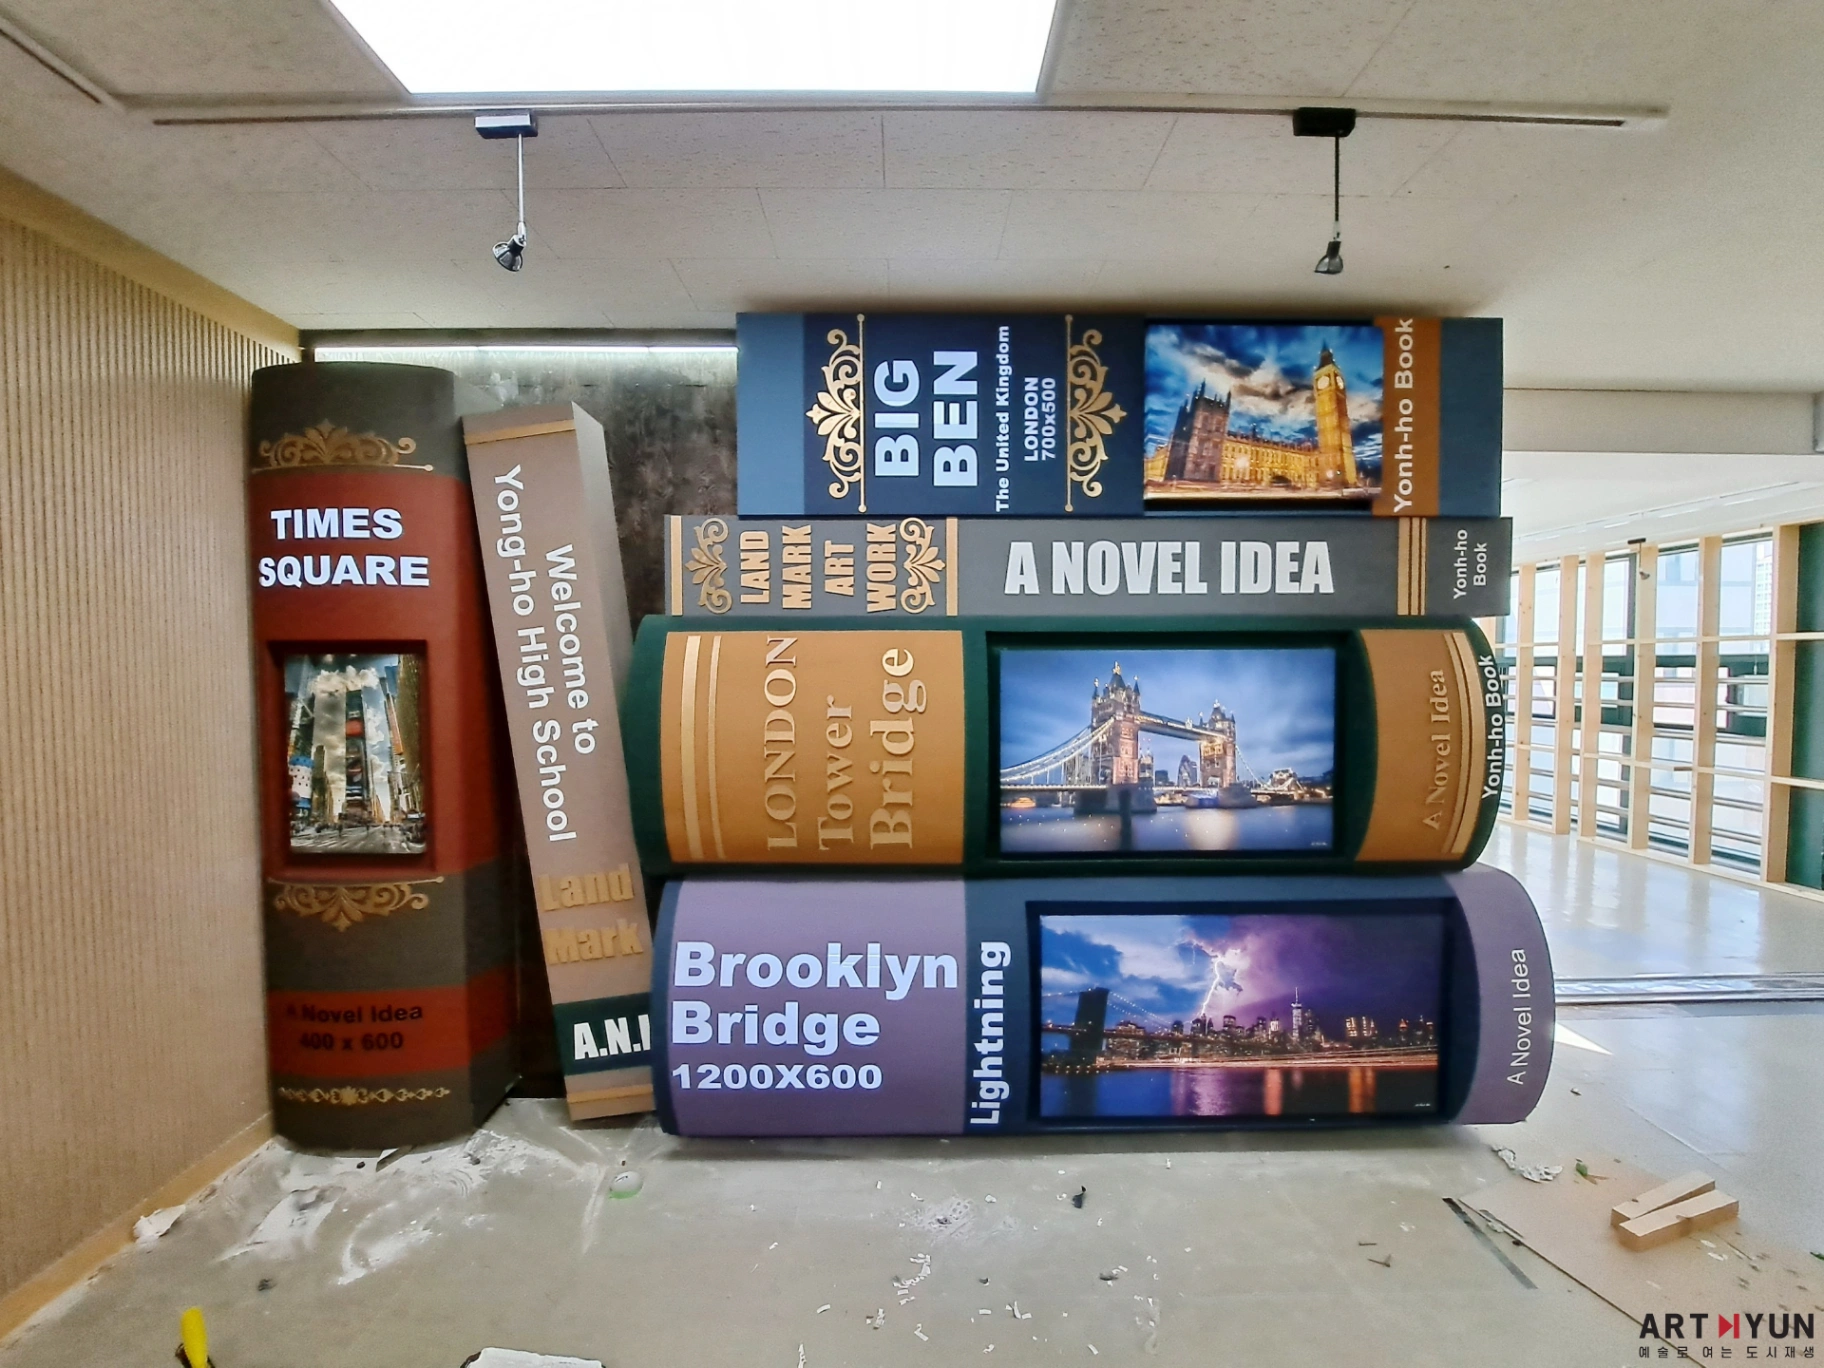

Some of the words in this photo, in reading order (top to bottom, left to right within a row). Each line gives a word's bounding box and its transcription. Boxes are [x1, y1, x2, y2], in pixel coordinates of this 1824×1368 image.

[996, 326, 1013, 409] Kingdom
[1394, 317, 1414, 389] Book
[874, 360, 920, 477] BIG
[933, 350, 978, 487] BEN
[996, 411, 1010, 472] United
[1024, 377, 1039, 462] LONDON
[1041, 377, 1056, 461] 700x500
[1393, 398, 1413, 513] Yonh-ho
[271, 508, 403, 540] TIMES
[996, 477, 1010, 512] The
[259, 555, 430, 588] SQUARE
[494, 464, 537, 616] Yong-ho
[739, 530, 770, 603] LAND
[782, 524, 812, 609] MARK
[824, 540, 855, 596] ART
[866, 523, 897, 613] WORK
[1004, 541, 1040, 595] A
[1052, 540, 1208, 595] NOVEL
[1220, 541, 1335, 595] IDEA
[1453, 528, 1468, 600] Yonh-ho
[1473, 542, 1488, 586] Book
[517, 627, 555, 709] High
[545, 543, 590, 709] Welcome
[572, 718, 599, 754] to
[1478, 654, 1502, 707] Book
[1428, 669, 1451, 723] Idea
[764, 635, 798, 850] LONDON
[817, 695, 854, 850] Tower
[870, 648, 927, 850] Bridge
[1426, 733, 1451, 805] Novel
[1481, 714, 1503, 799] Yonh-ho
[532, 719, 577, 842] School
[1422, 812, 1442, 831] A
[538, 862, 634, 912] Land
[544, 918, 644, 965] Mark
[674, 941, 958, 1000] Brooklyn
[1511, 948, 1531, 998] Idea
[301, 1004, 362, 1023] Novel
[371, 1005, 423, 1022] Idea
[361, 1032, 403, 1050] 600
[671, 1000, 880, 1056] Bridge
[970, 941, 1011, 1125] Lightning
[1510, 1007, 1532, 1066] Novel
[671, 1064, 883, 1090] 1200X600
[1507, 1071, 1527, 1085] A
